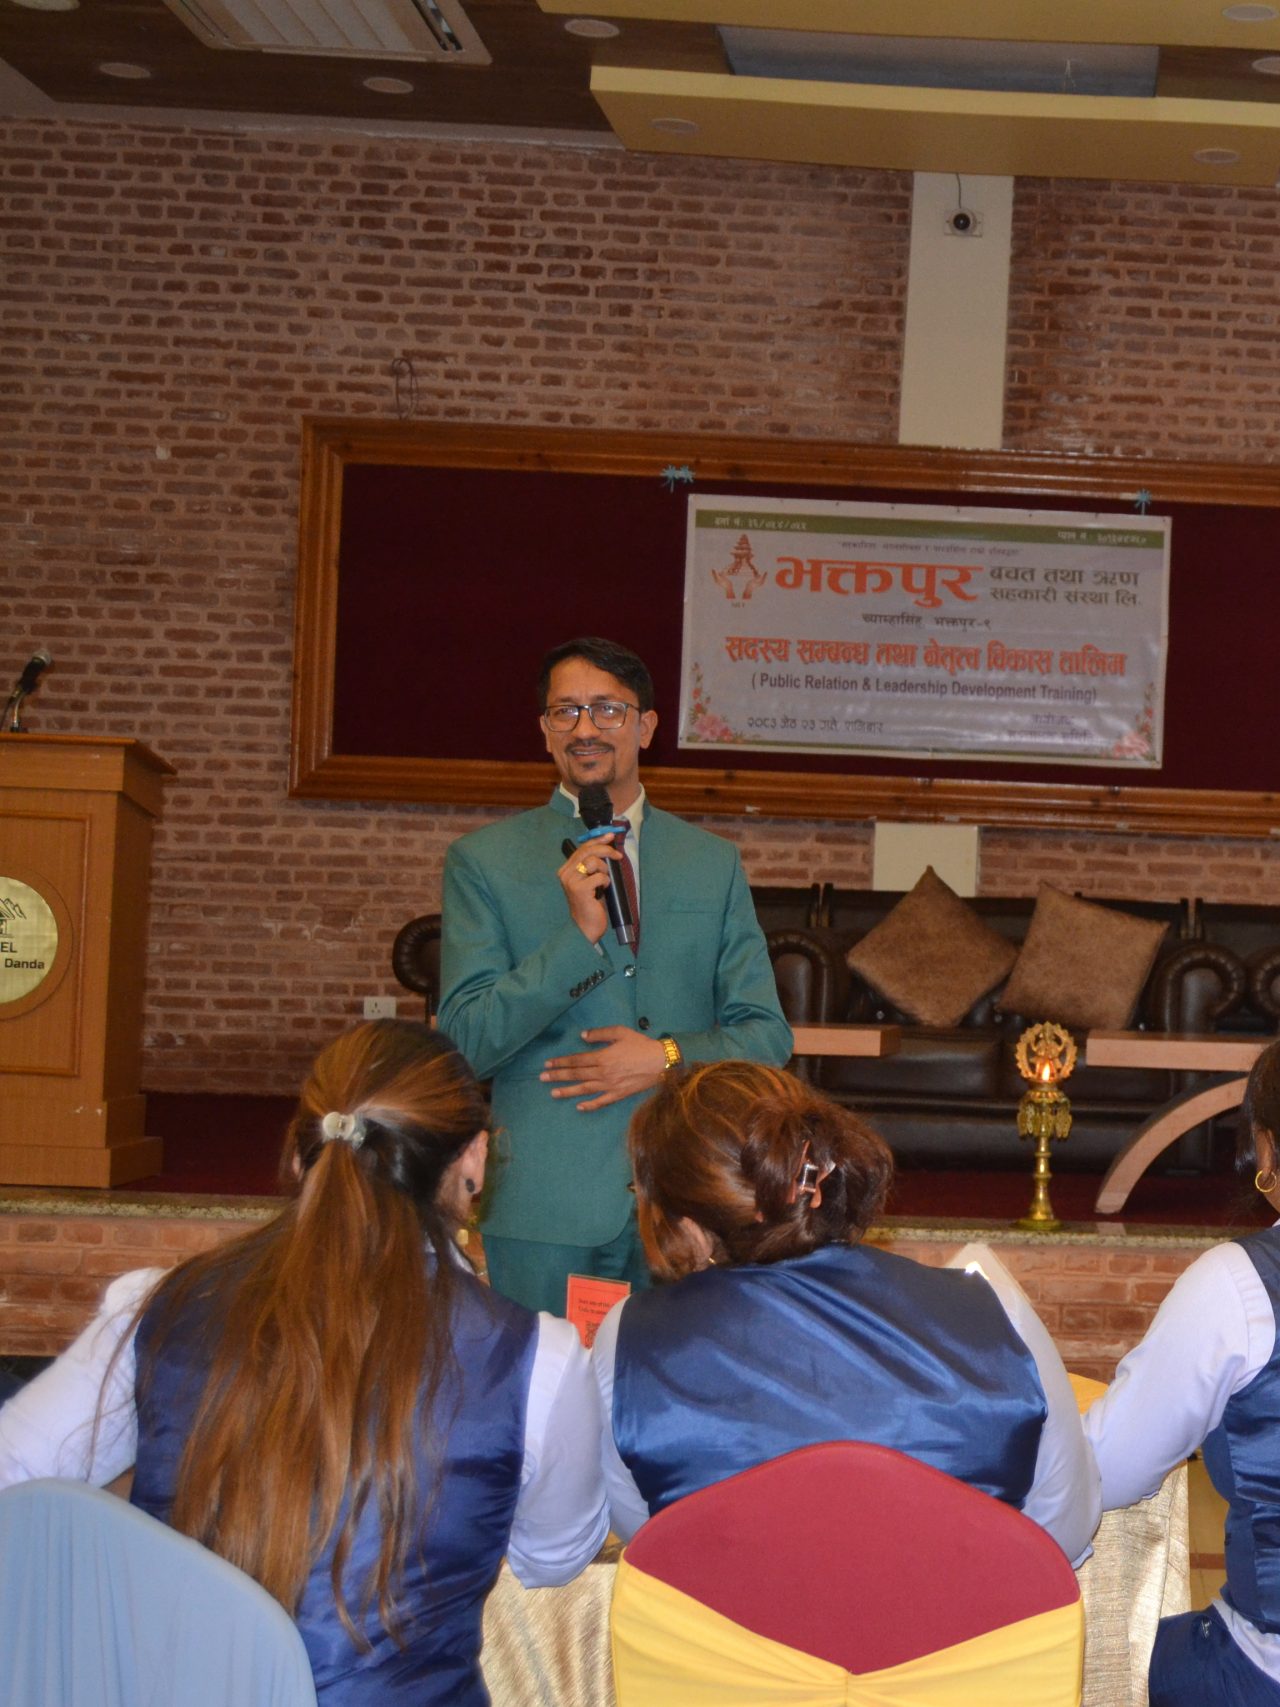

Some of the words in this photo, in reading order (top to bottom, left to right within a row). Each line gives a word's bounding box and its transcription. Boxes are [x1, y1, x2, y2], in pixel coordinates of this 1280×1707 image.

[775, 556, 985, 608] भक्तपुर
[989, 565, 1035, 583] बचत
[1043, 567, 1085, 585] तथा
[1093, 570, 1140, 587] ऋण
[989, 586, 1057, 602] सहकारी
[1064, 588, 1109, 605] संस्था
[725, 636, 791, 664] सदस्य
[796, 639, 871, 665] सम्बन्ध
[876, 642, 918, 667] तथा
[986, 639, 1054, 676] विकास
[1059, 643, 1128, 676] तालिम
[760, 672, 800, 689] Public
[805, 675, 858, 691] Relation
[862, 677, 871, 691] &
[876, 678, 948, 698] Leadership
[952, 681, 1036, 701] Development
[1040, 685, 1097, 705] Training)
[4, 958, 45, 970] Danda
